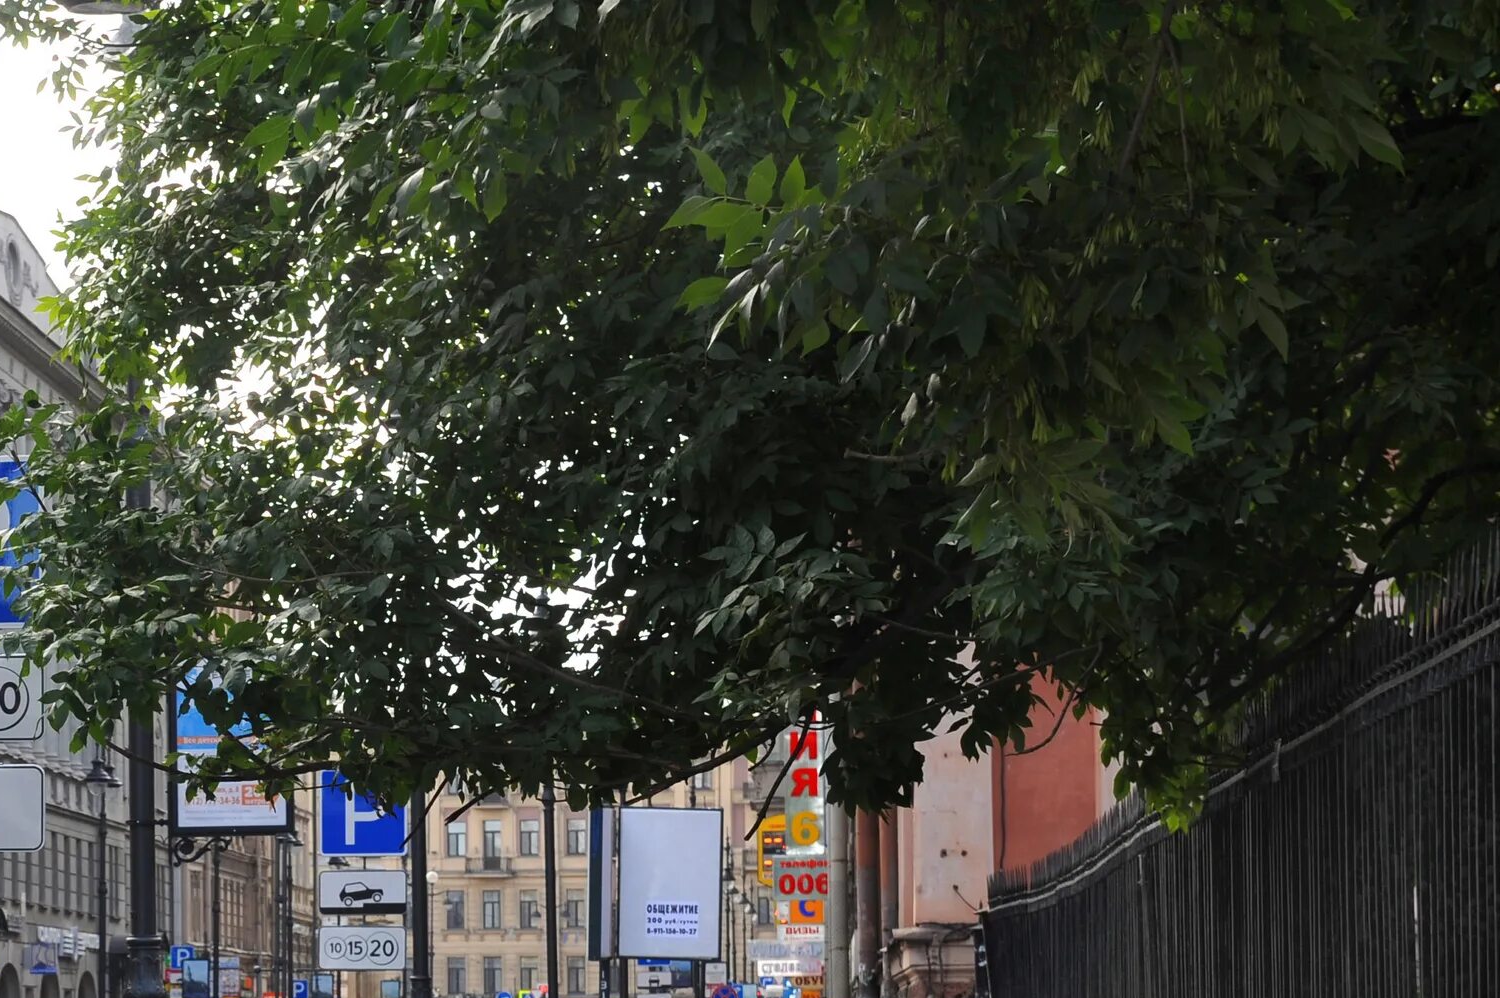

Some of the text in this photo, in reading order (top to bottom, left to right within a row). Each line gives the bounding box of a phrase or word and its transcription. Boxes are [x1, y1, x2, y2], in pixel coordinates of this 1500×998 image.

[647, 904, 699, 915] ОБЩЕЖИТИЕ
[330, 939, 394, 957] 10 15 20
